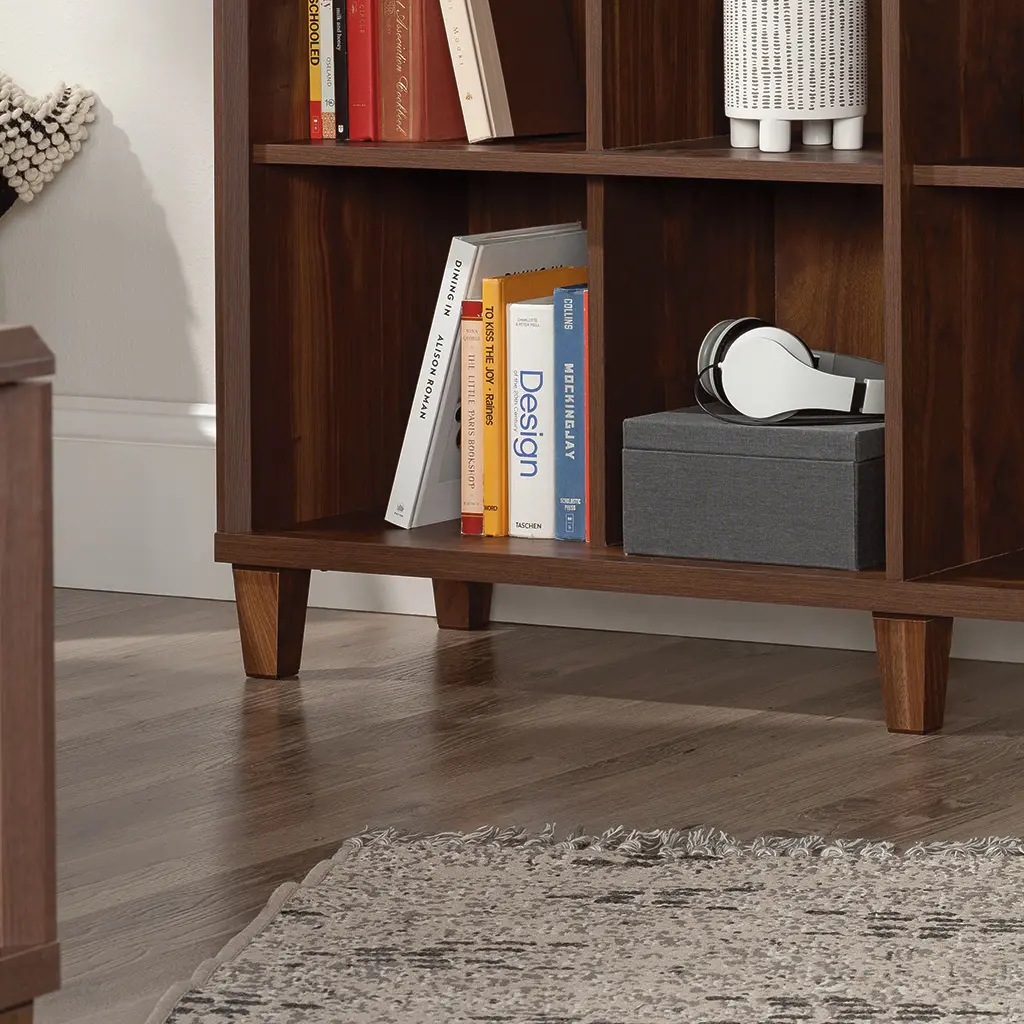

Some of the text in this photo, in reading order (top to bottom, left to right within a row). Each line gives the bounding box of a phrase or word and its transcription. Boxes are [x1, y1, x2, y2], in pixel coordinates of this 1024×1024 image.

[396, 9, 408, 72] Association
[396, 76, 408, 136] Cookbook
[444, 260, 462, 316] DINING IN
[564, 298, 573, 330] COLLINS
[420, 334, 444, 420] ALISON ROMAN
[485, 306, 494, 426] TO KISS THE JOY Raines
[513, 370, 544, 477] Design
[565, 363, 575, 460] MOCKINGJAY
